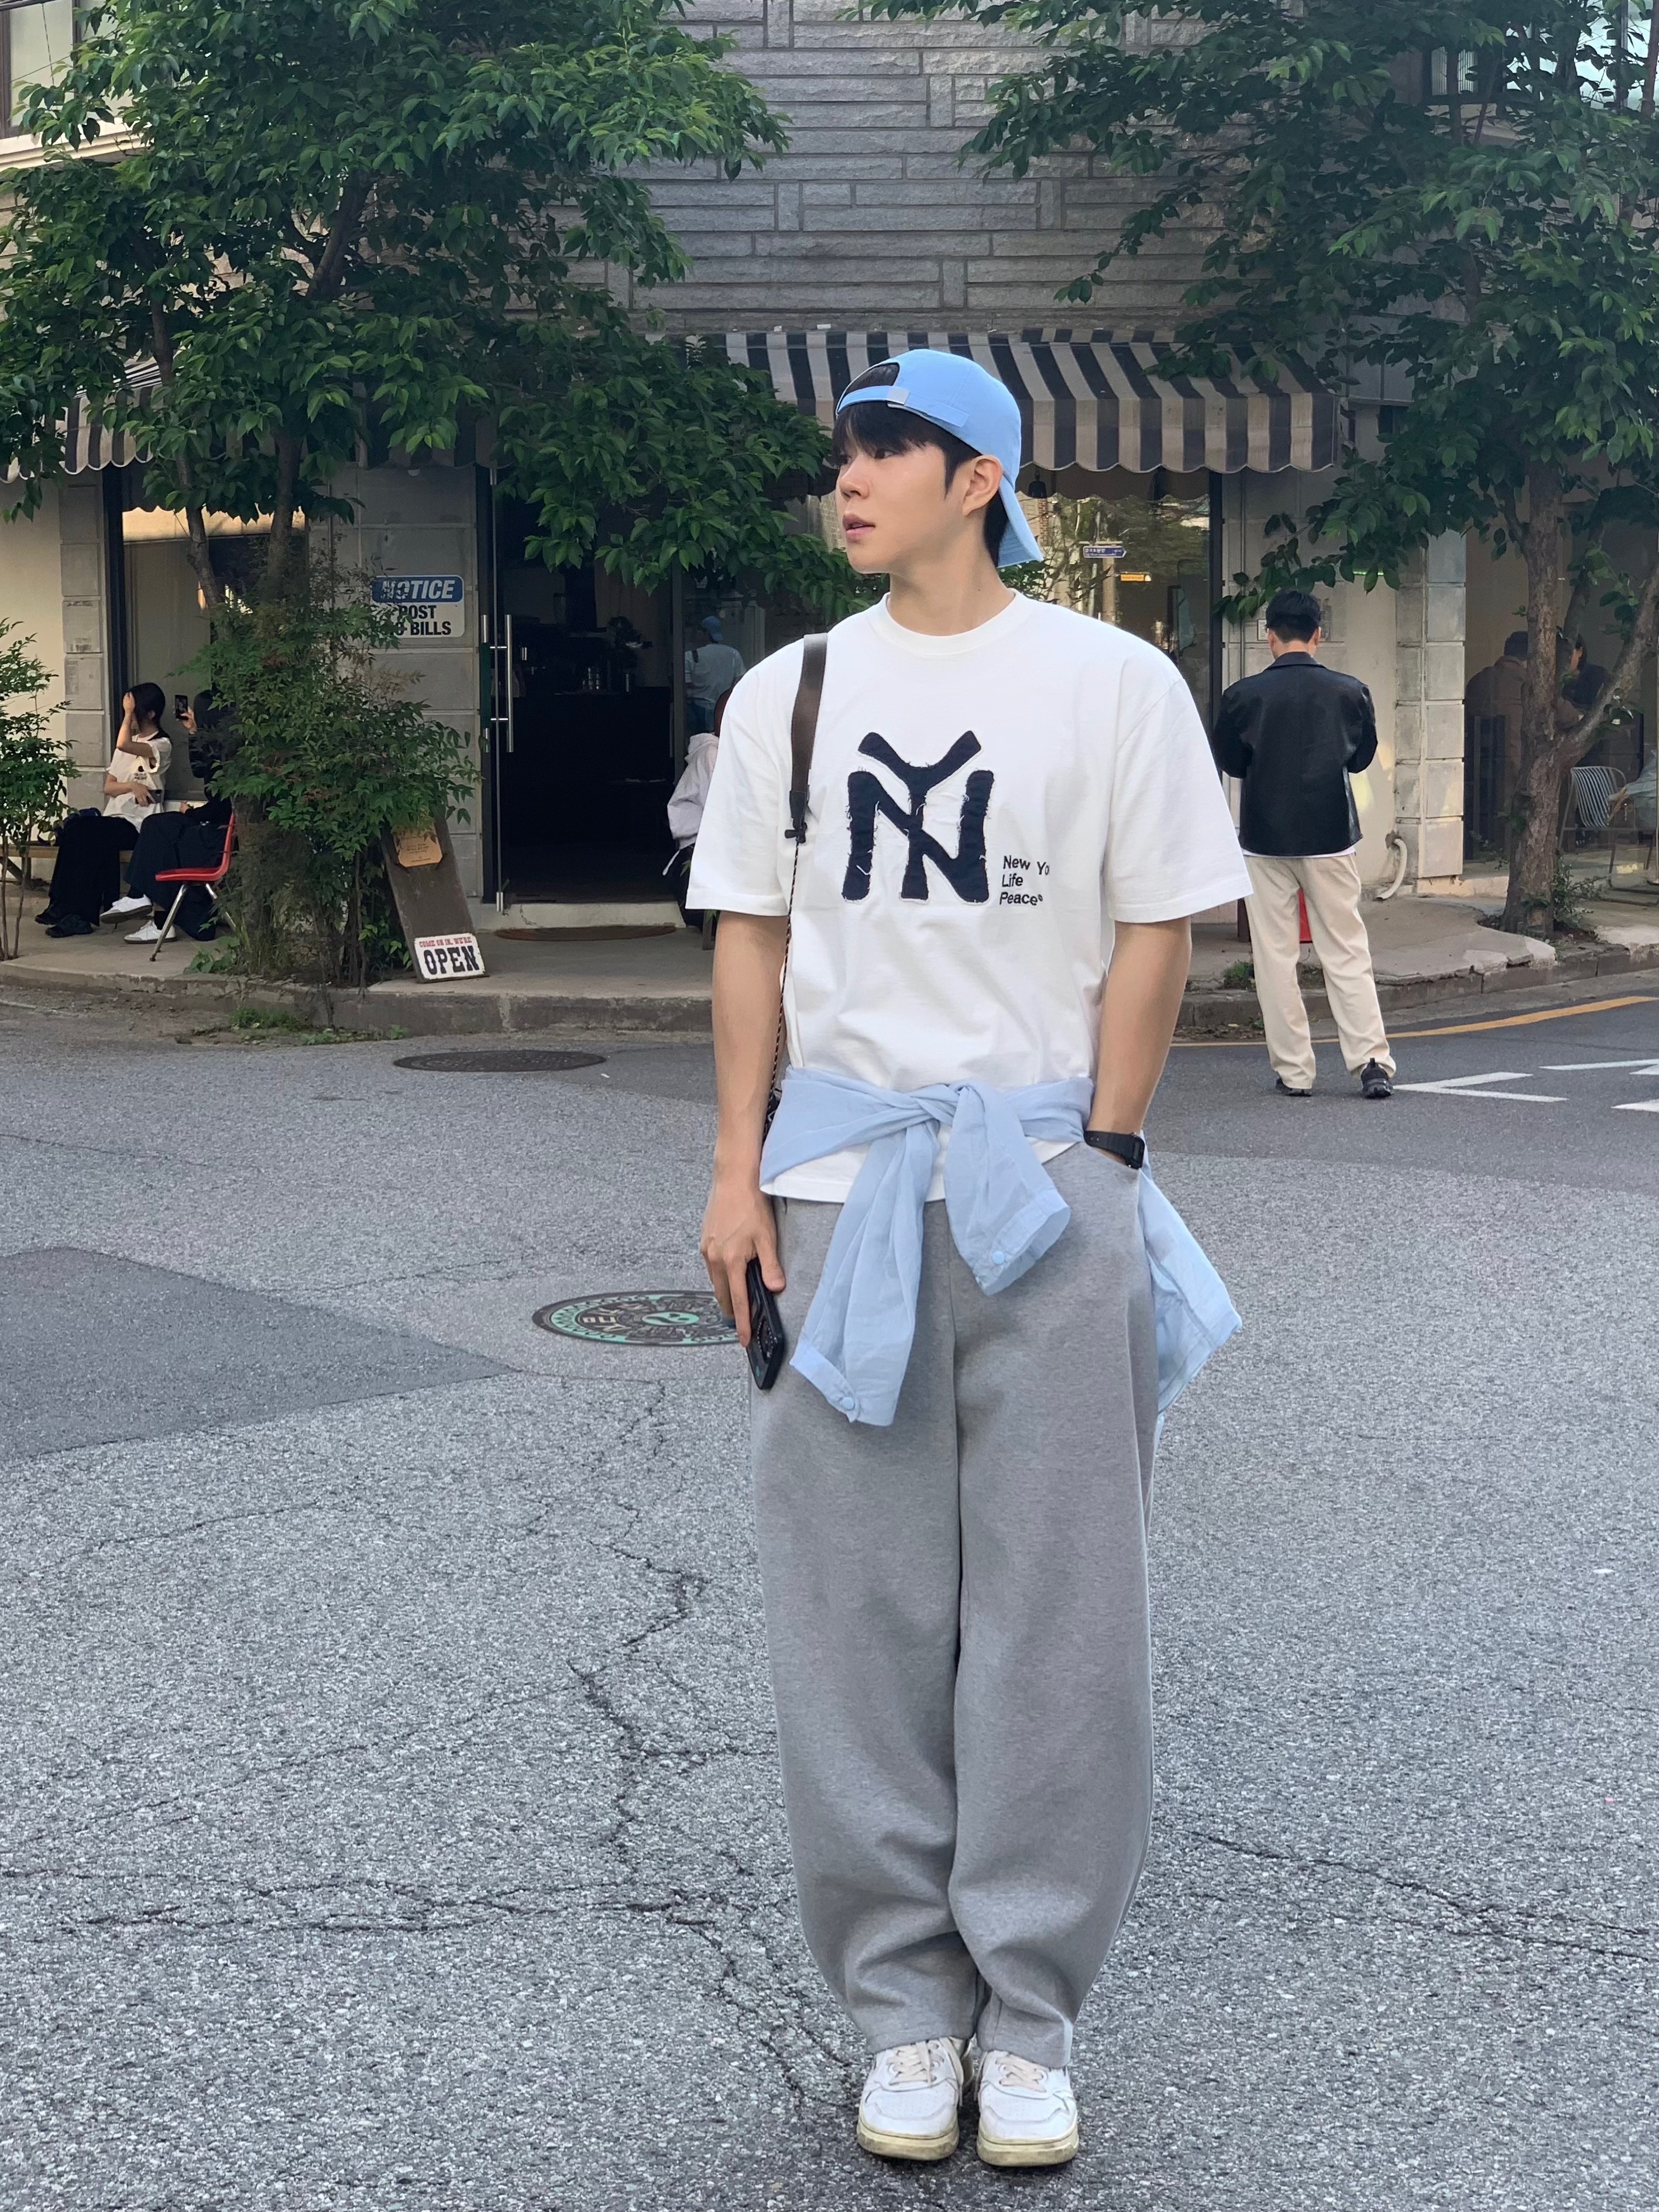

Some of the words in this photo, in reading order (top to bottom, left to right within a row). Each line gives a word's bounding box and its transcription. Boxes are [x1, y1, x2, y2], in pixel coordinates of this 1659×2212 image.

[380, 580, 455, 599] NOTICE
[399, 605, 437, 619] POST
[411, 621, 451, 636] BILLS
[841, 730, 995, 904] NY
[1003, 855, 1031, 870] New
[1002, 873, 1023, 887] Life
[454, 936, 472, 944] WE'RE
[423, 945, 479, 975] OPEN
